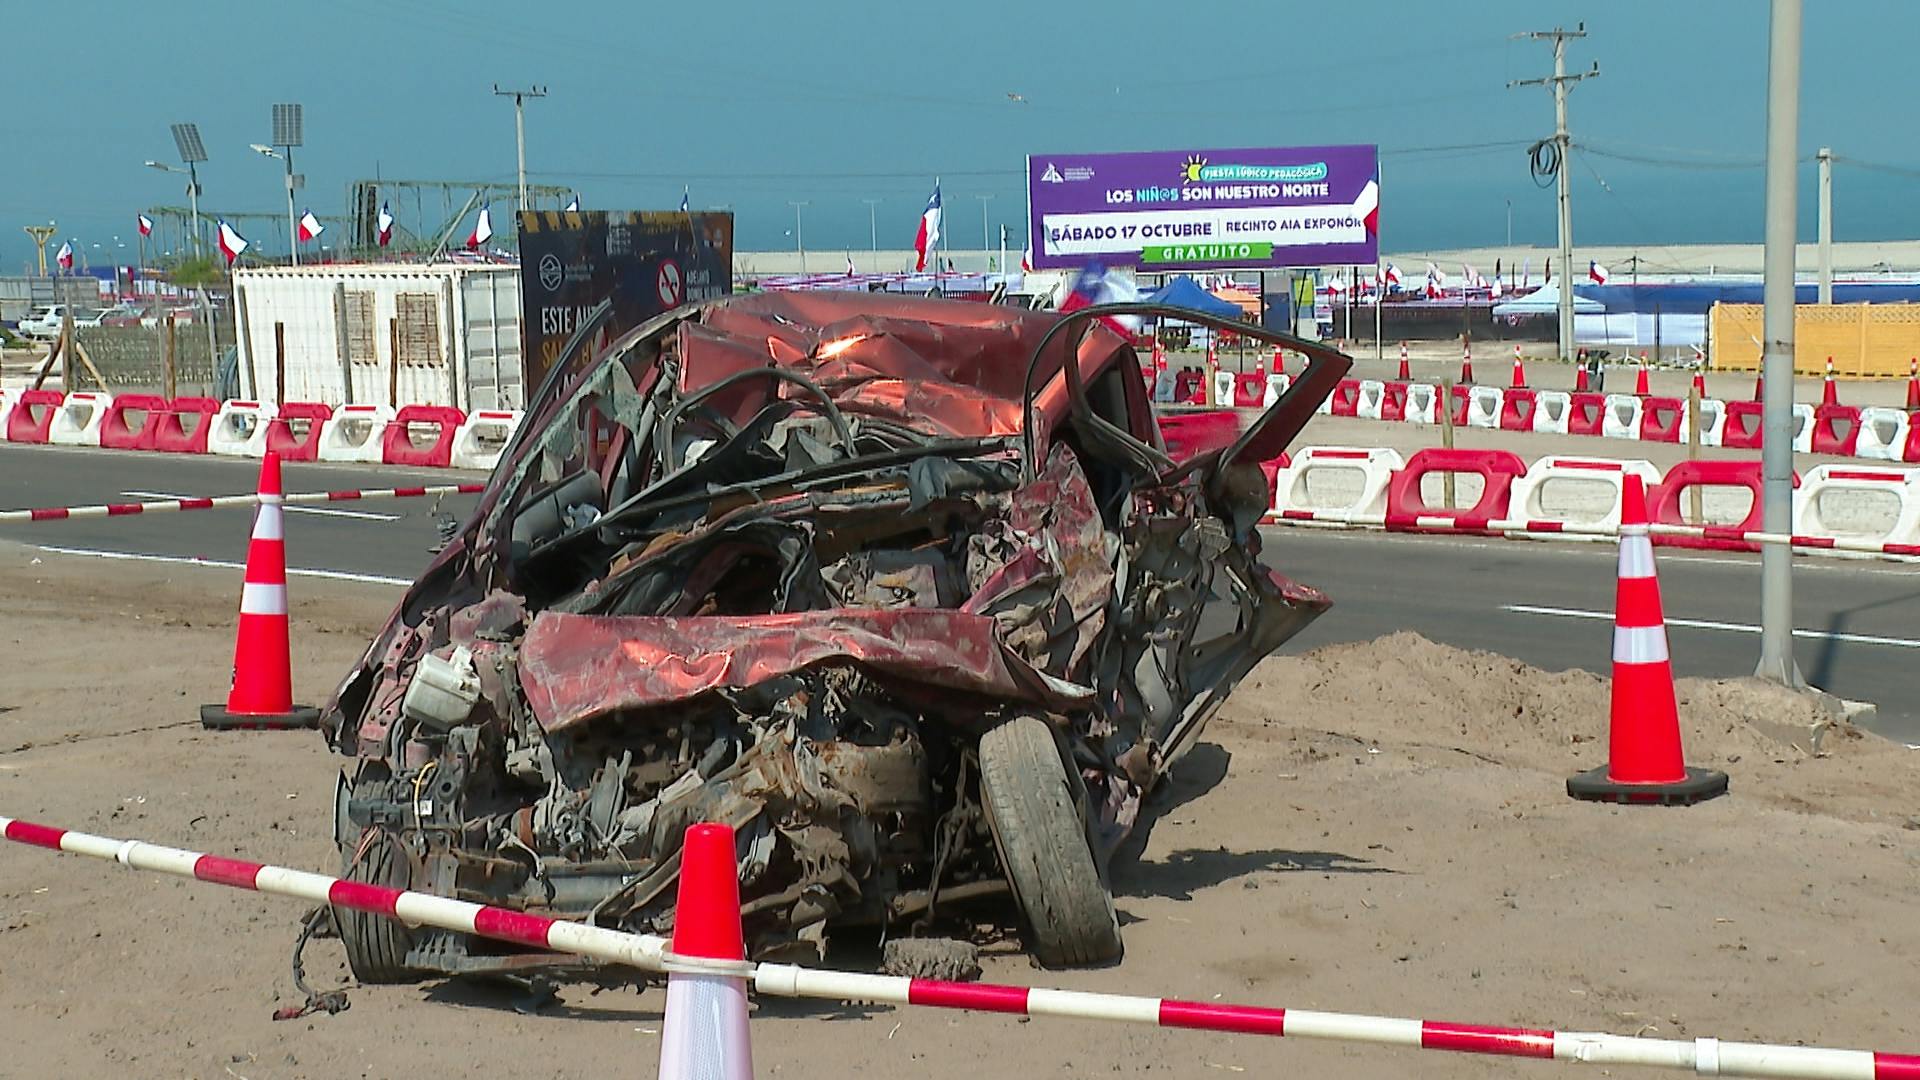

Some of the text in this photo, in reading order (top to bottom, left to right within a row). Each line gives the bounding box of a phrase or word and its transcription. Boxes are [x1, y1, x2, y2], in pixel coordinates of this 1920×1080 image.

[1204, 166, 1322, 179] FIESTA LÚDICO PEDAGÓGICA
[1106, 190, 1133, 203] LOS
[1182, 187, 1212, 201] SON
[1215, 185, 1280, 199] NUESTRO
[1282, 183, 1329, 197] NORTE
[1051, 222, 1212, 242] SÁBADO 17 OCTUBRE
[1226, 219, 1277, 232] RECINTO
[1280, 219, 1301, 230] AIA
[1163, 246, 1251, 260] GRATUITO
[541, 307, 572, 335] ESTE
